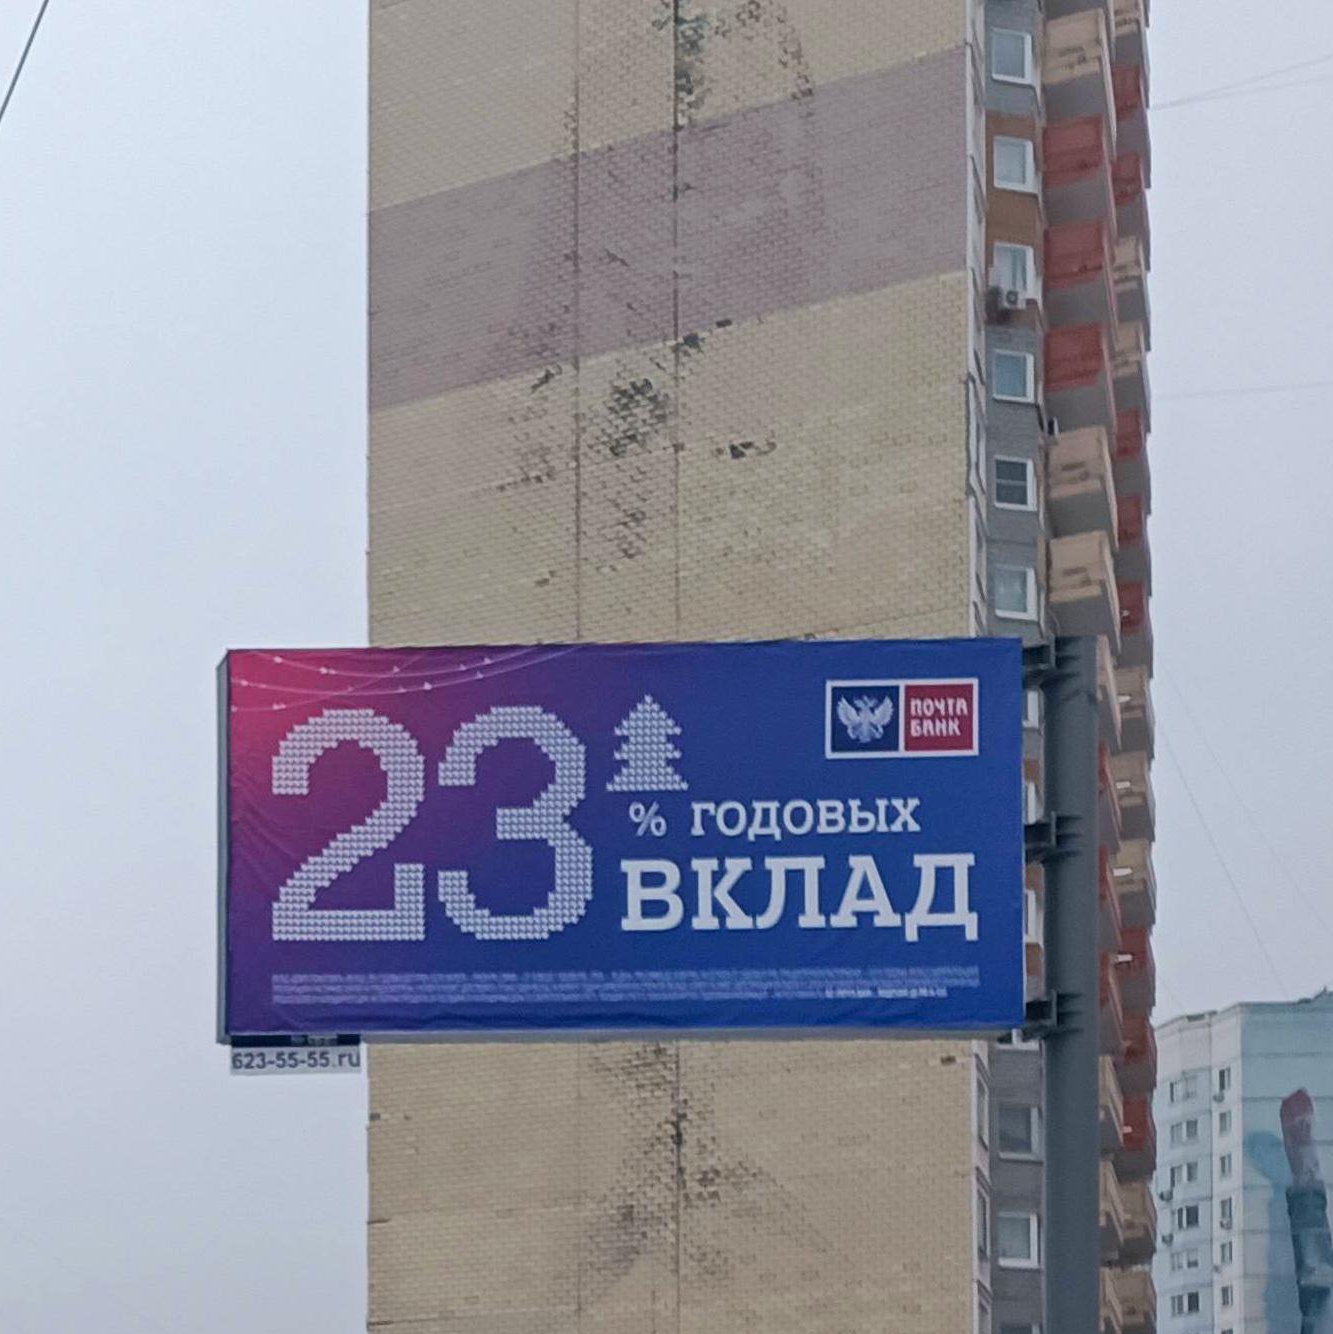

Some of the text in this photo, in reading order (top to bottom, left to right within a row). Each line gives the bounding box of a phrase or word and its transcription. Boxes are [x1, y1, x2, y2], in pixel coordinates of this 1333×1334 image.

[910, 697, 968, 716] ПОЧТА
[910, 717, 961, 737] БАНК
[272, 706, 593, 941] 23
[628, 797, 922, 842] % ГОДОВЫХ
[620, 852, 979, 942] ВКЛАД
